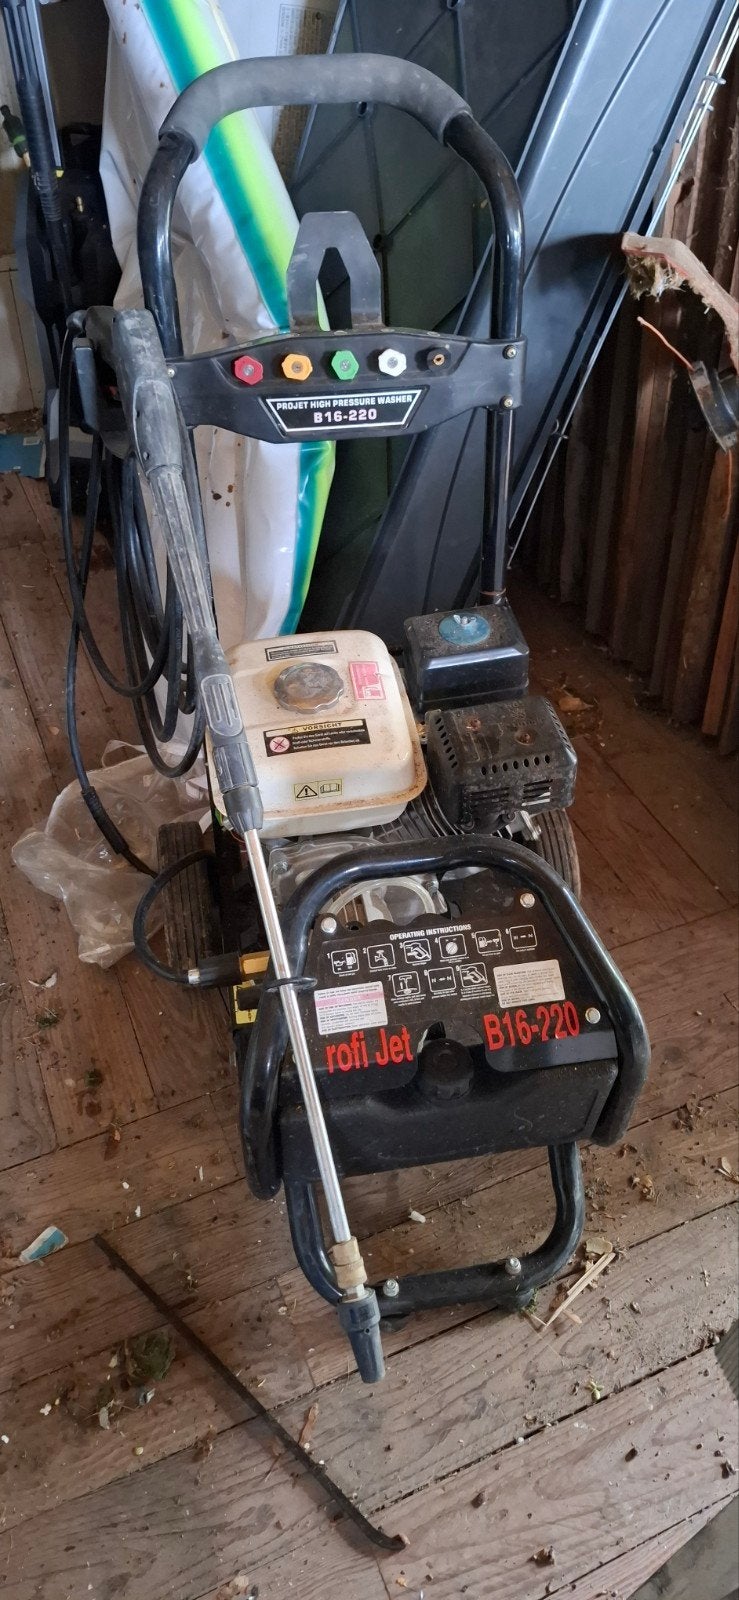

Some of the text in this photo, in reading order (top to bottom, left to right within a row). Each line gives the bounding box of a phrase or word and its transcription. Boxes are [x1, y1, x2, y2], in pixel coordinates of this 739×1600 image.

[276, 395, 413, 411] PROJET HIGH PRESSURE WASHER
[313, 408, 378, 424] B16-220
[302, 722, 342, 731] VORSICHT
[389, 924, 472, 941] OPERATING INSTRUCTIONS
[483, 1001, 580, 1052] B16-220
[326, 1024, 414, 1074] rofi Jet
